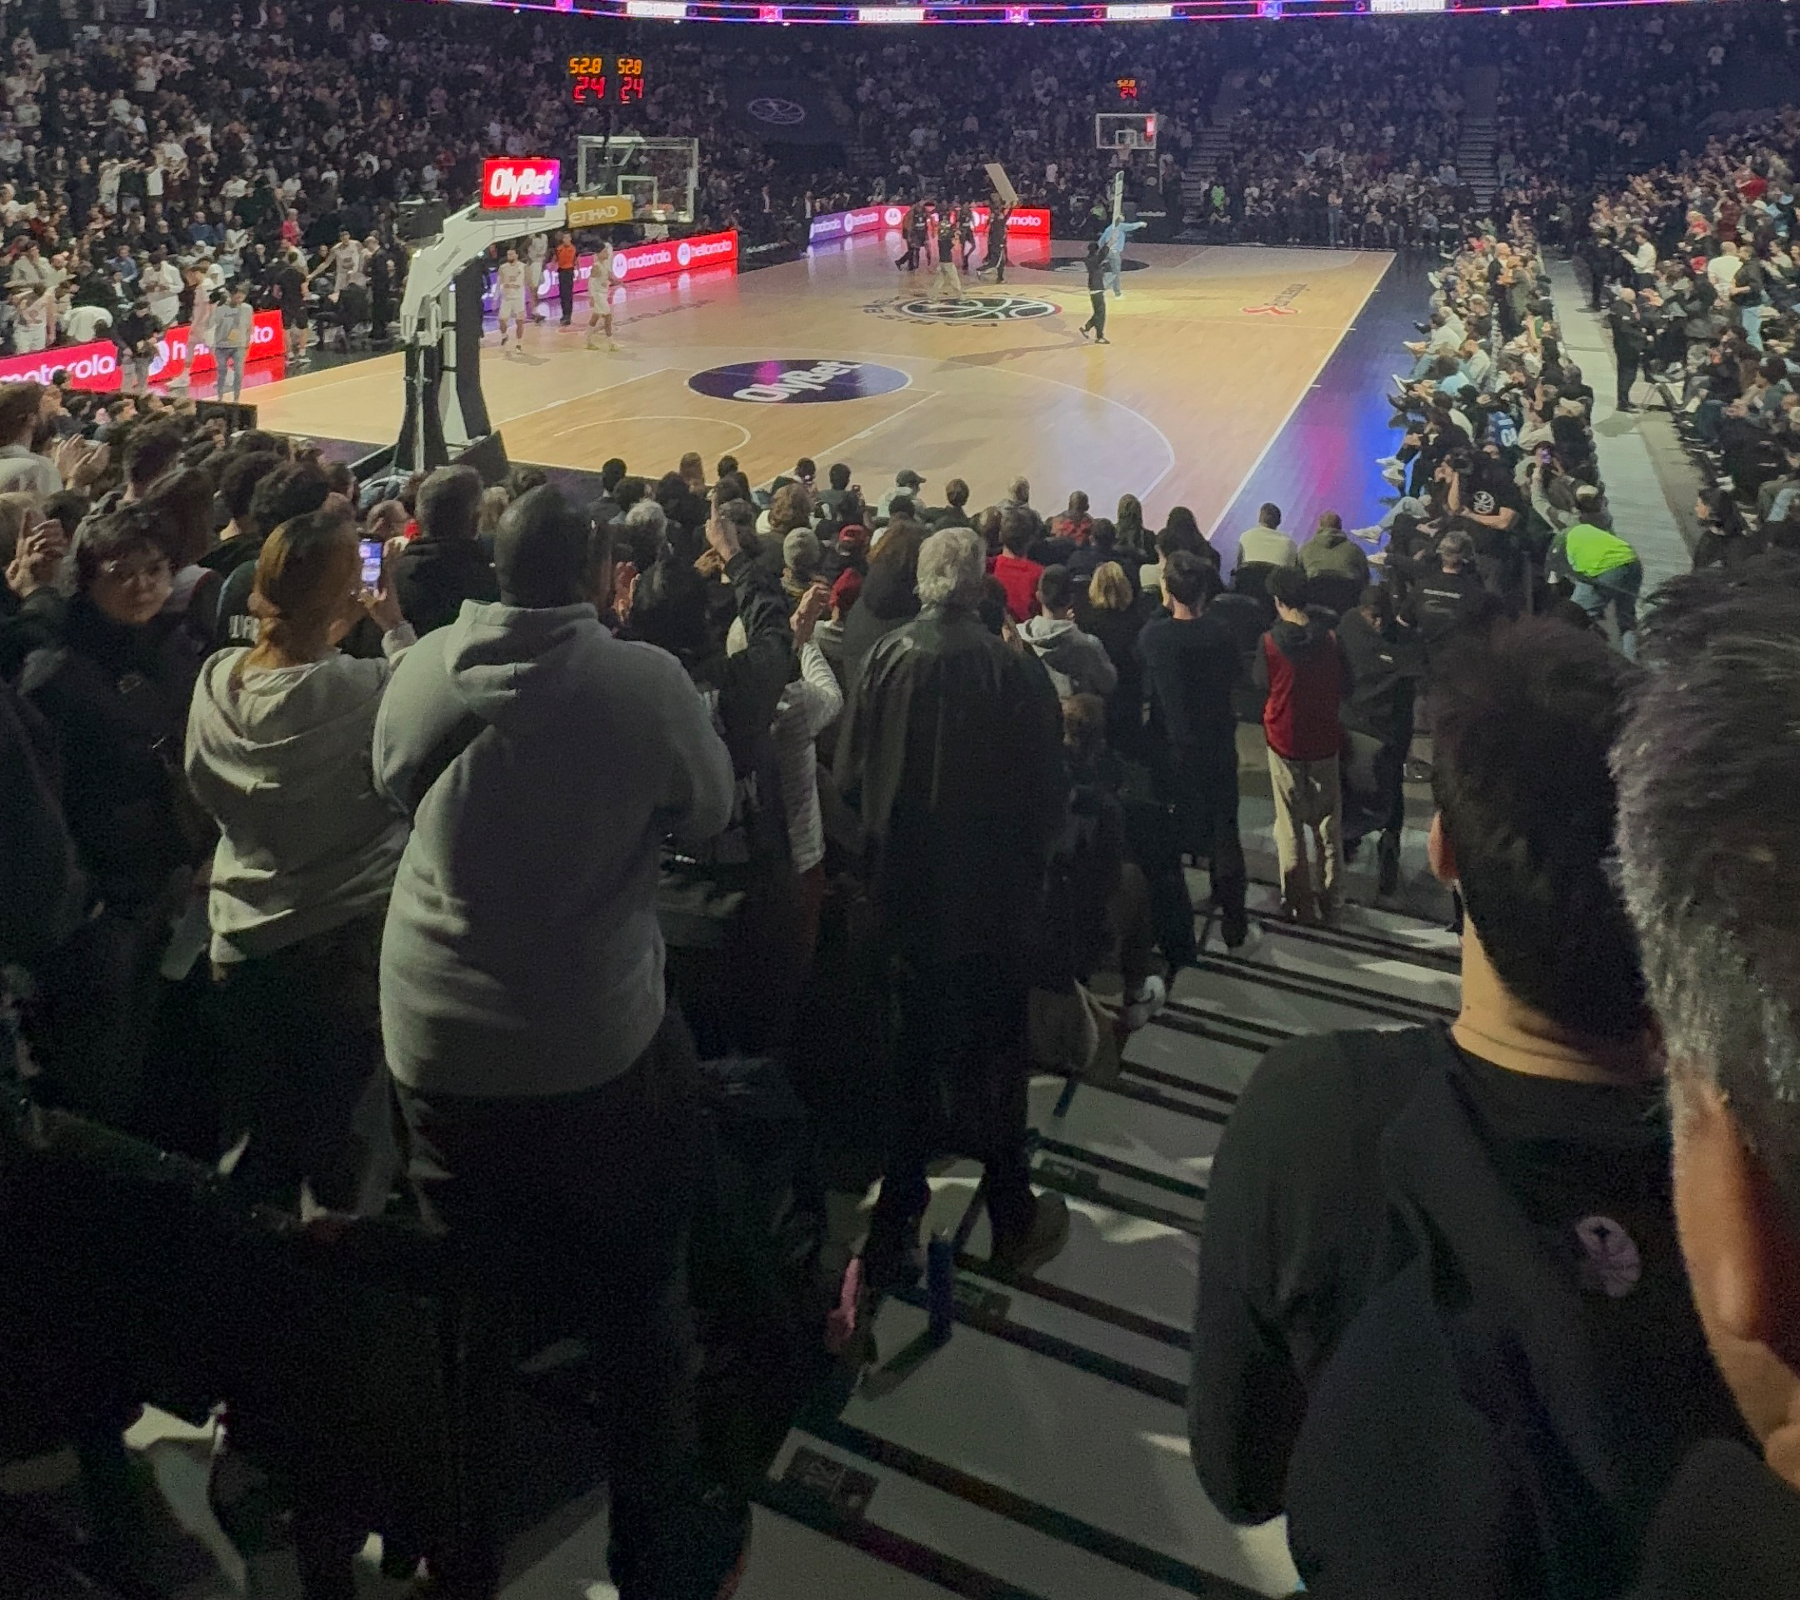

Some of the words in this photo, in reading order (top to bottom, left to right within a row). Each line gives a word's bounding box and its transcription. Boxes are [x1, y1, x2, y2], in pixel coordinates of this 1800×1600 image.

[573, 76, 606, 99] 24
[620, 76, 645, 100] 24
[1120, 87, 1138, 100] 24
[490, 167, 555, 203] OlyBet
[569, 205, 619, 224] ETIHAD
[628, 249, 672, 269] motorola
[733, 360, 862, 402] OlyBet
